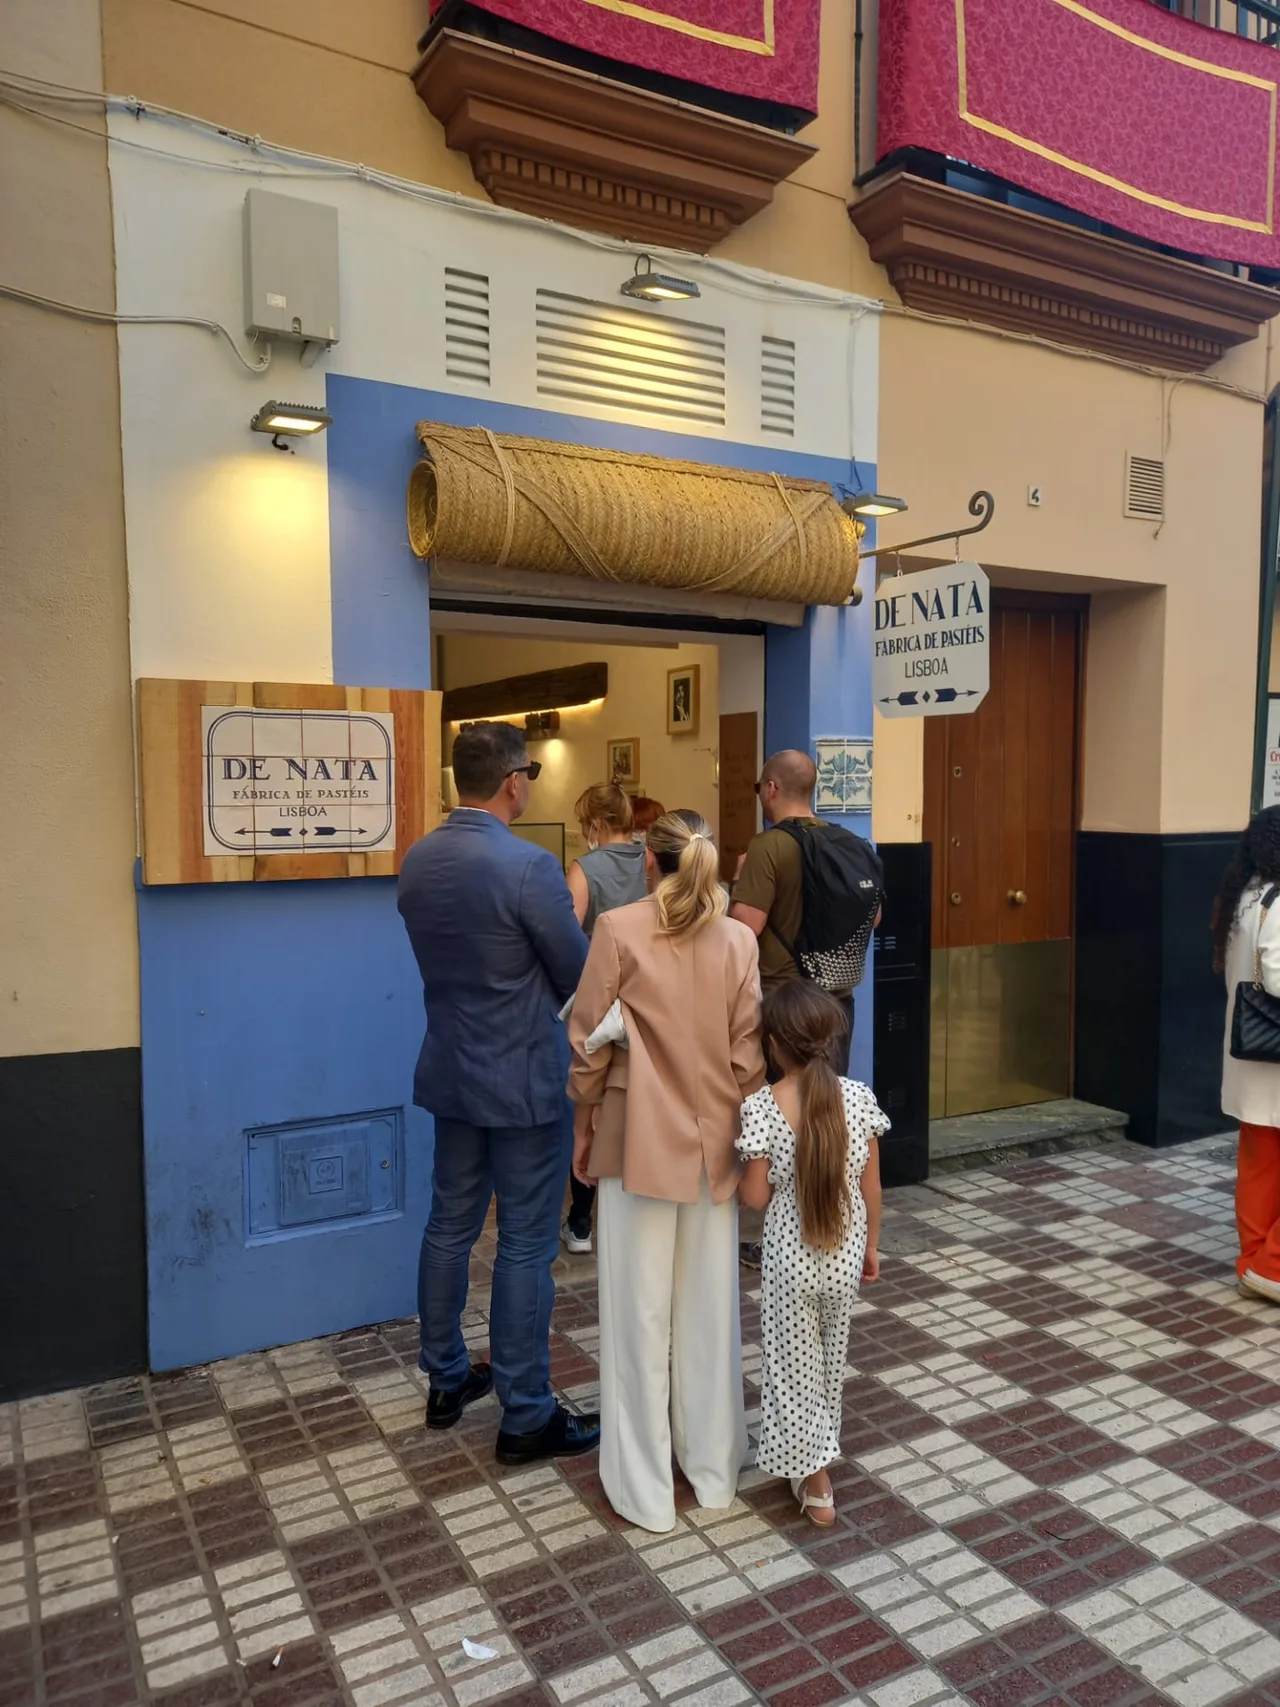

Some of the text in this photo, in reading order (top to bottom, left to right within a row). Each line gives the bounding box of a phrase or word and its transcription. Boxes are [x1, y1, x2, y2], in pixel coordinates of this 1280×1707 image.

[874, 580, 985, 632] DE NATA
[924, 631, 939, 650] DE
[940, 624, 985, 649] PASTÉIS
[904, 657, 949, 679] LISBOA
[221, 758, 379, 781] DE NATA
[232, 785, 370, 800] FÁBRICA DE PASTÉIS
[279, 806, 328, 818] LISBOA
